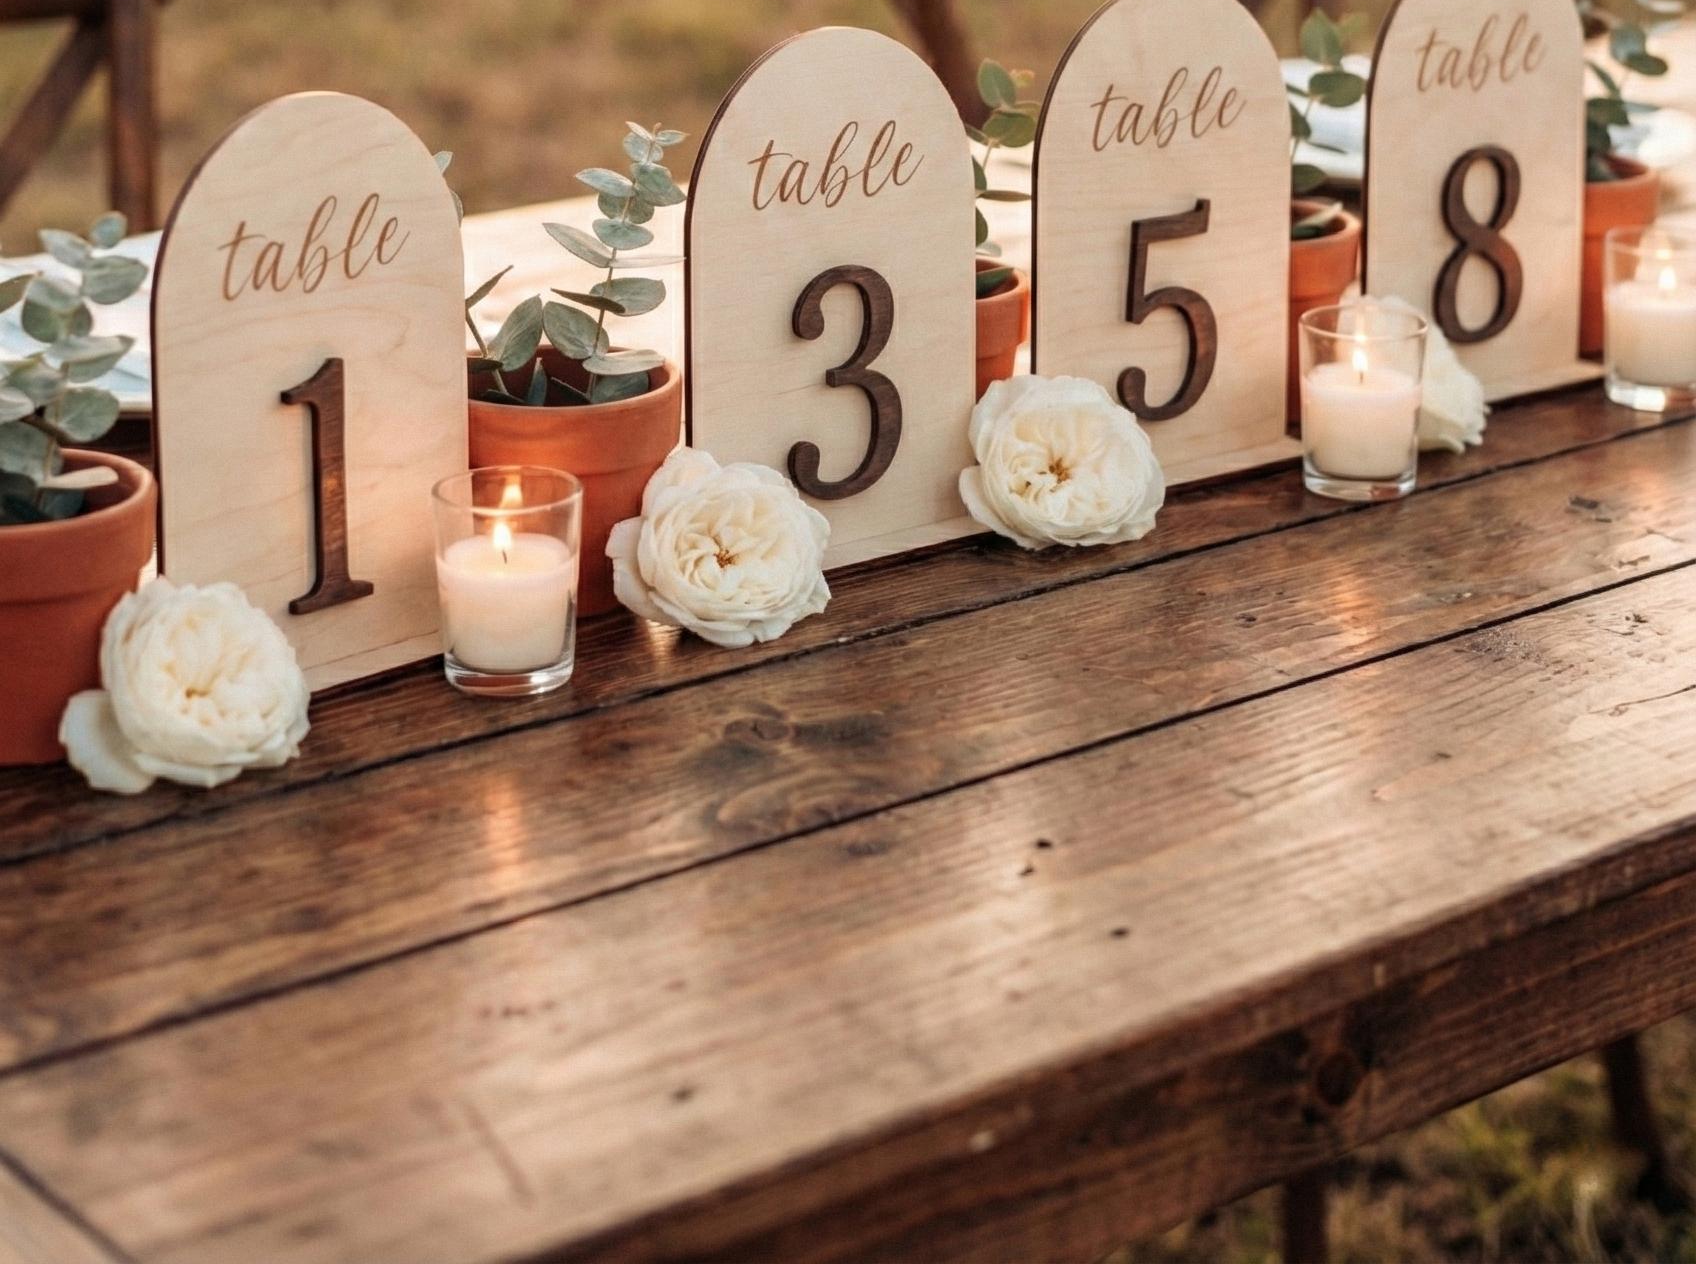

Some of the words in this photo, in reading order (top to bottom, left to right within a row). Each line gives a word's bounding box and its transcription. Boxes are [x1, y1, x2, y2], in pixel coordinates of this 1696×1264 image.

[1090, 66, 1247, 151] table
[1416, 12, 1549, 93] table
[747, 120, 924, 210] table
[218, 193, 411, 302] table
[1116, 198, 1218, 422] 5
[1433, 144, 1524, 344] 8
[786, 264, 903, 501] 3
[279, 356, 374, 615] 1
